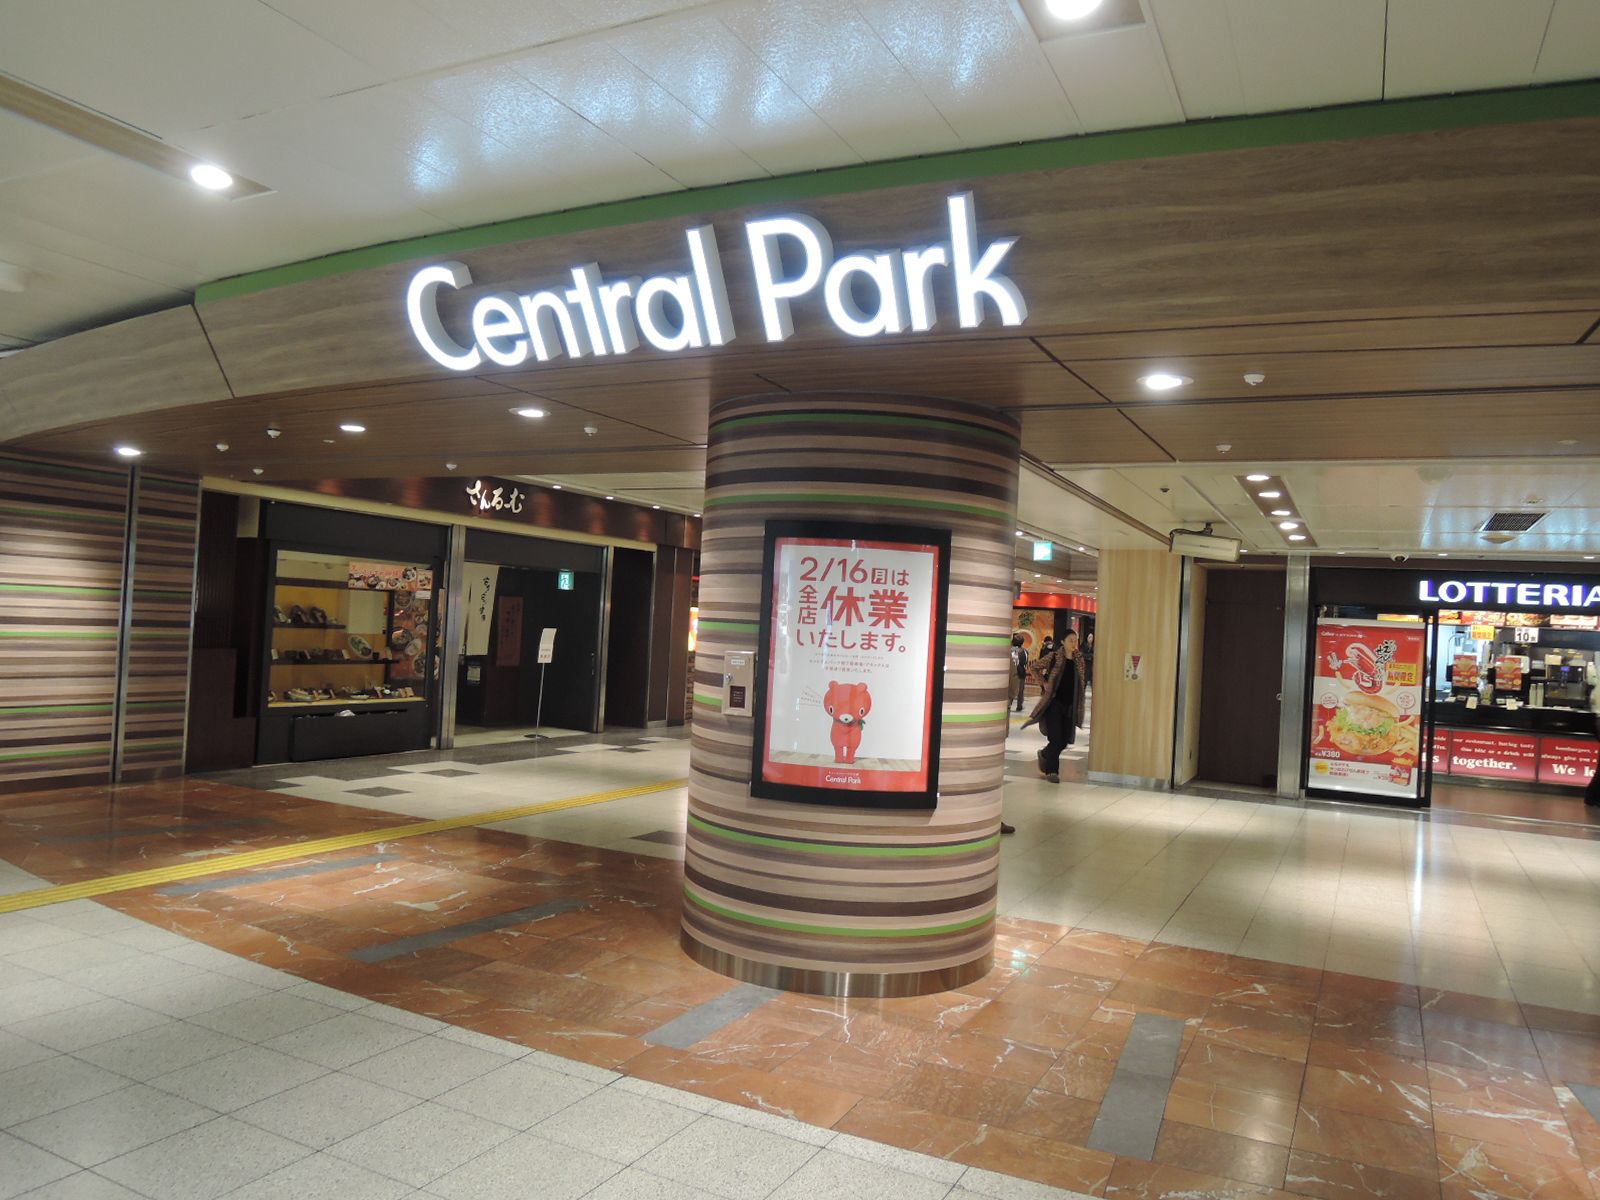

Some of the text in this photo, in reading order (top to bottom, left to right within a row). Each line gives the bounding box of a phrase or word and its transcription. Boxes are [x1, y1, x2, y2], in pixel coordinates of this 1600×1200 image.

[406, 191, 1027, 371] Central Park
[466, 480, 525, 513] さんるーむ
[1419, 580, 1600, 607] LOTTERIA
[796, 629, 906, 653] いたします。
[1452, 755, 1518, 770] together.
[1552, 763, 1576, 775] We
